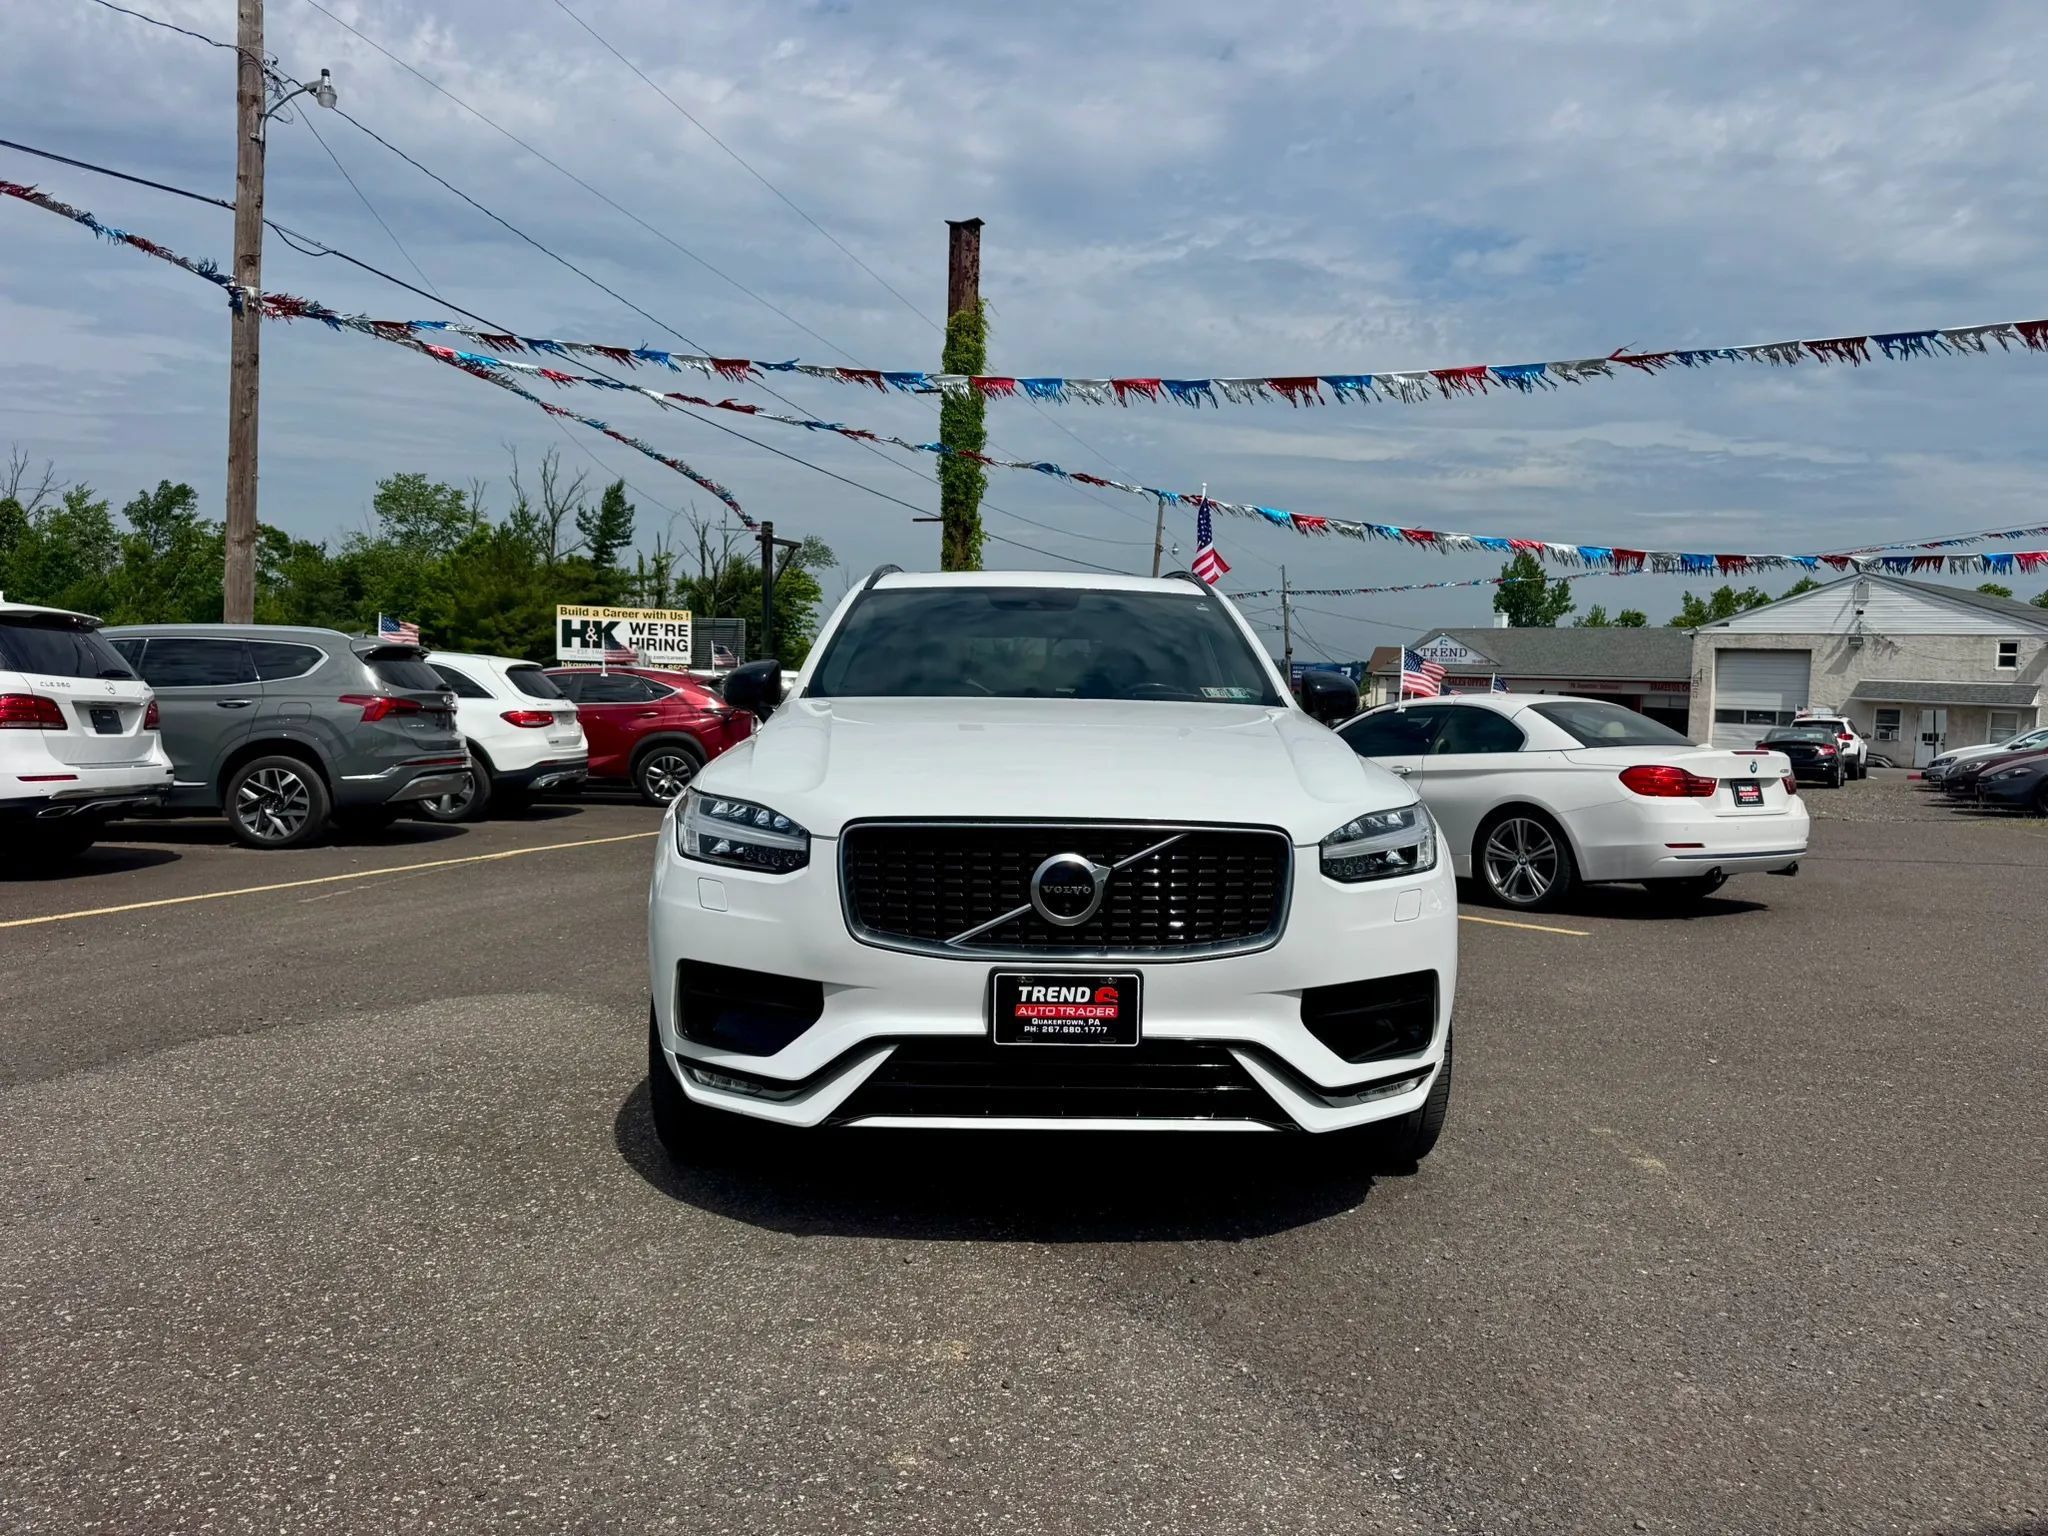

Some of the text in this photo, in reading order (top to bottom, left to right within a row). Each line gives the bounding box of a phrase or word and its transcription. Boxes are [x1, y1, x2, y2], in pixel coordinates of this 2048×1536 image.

[560, 606, 589, 617] Build
[593, 609, 599, 617] a
[603, 608, 639, 619] Career
[643, 609, 666, 620] with
[562, 619, 622, 649] H&K
[630, 622, 688, 637] WE'RE
[629, 637, 688, 652] HIRING
[1421, 648, 1468, 658] TREND
[1041, 885, 1092, 895] VOLVO
[1018, 986, 1091, 1003] TREND
[1017, 1006, 1115, 1016] AUTO TRADER
[1088, 1018, 1100, 1026] PA
[1024, 1025, 1108, 1034] PH: 267.680.1777
